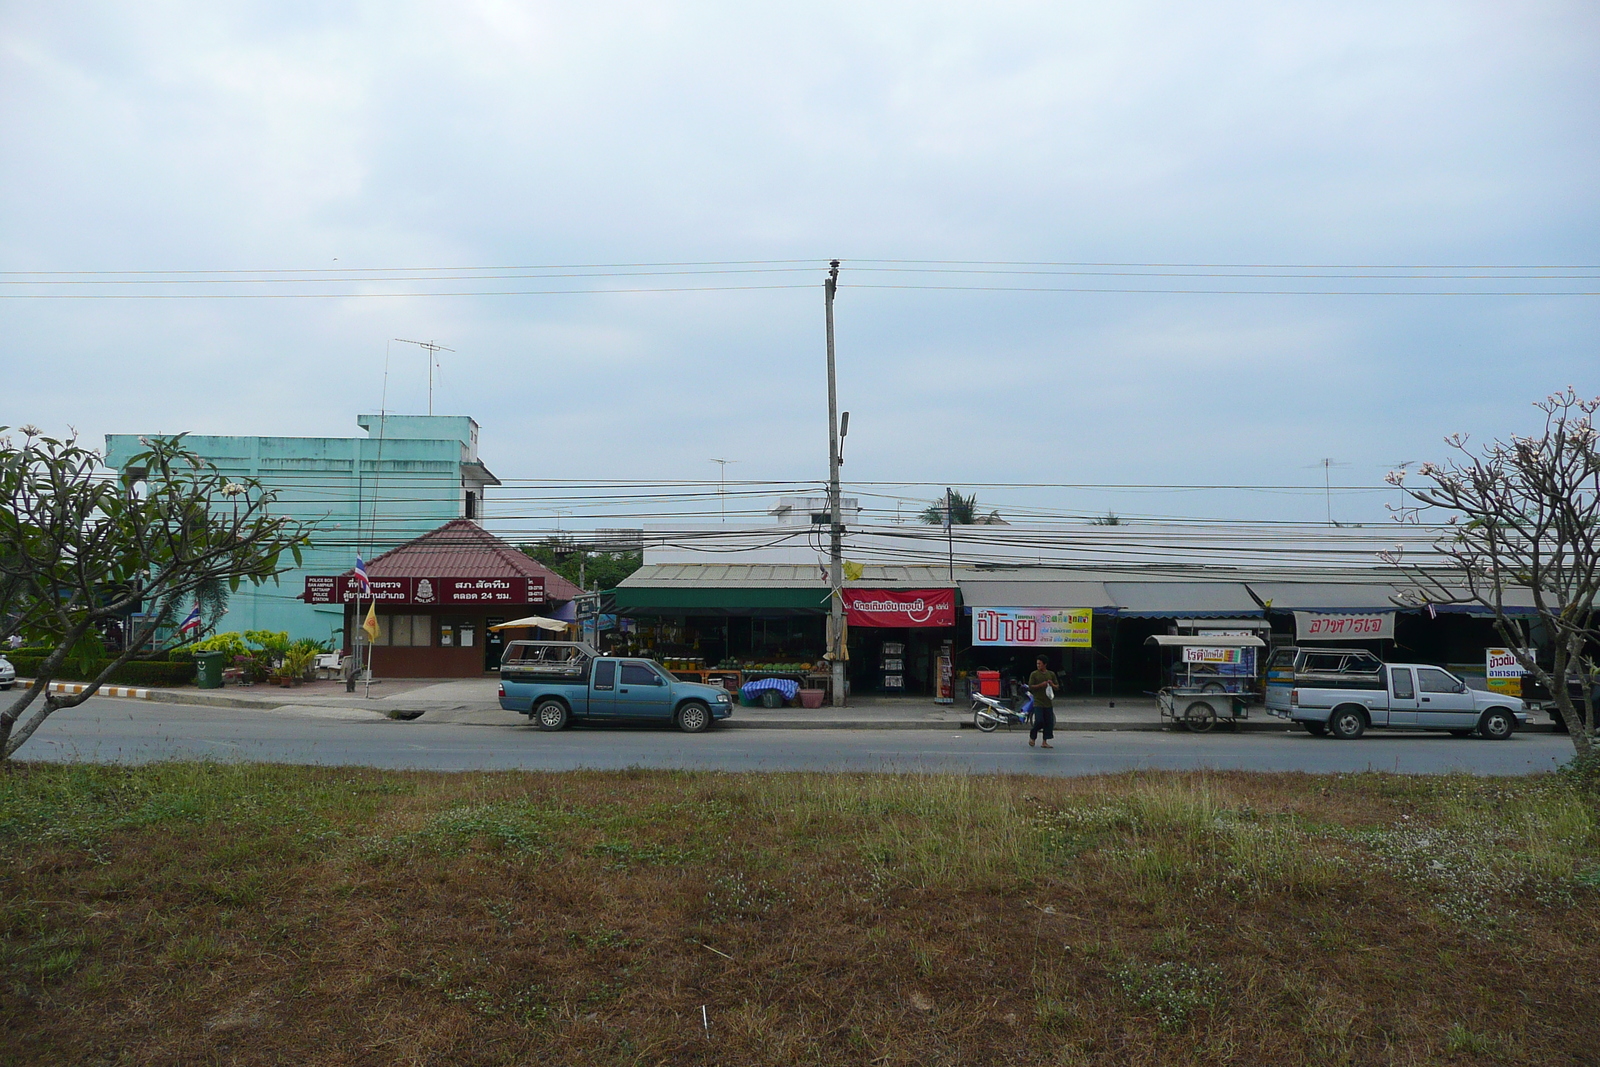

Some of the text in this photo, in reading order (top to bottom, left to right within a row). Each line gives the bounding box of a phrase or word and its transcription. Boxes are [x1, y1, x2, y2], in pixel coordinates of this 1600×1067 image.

[343, 590, 405, 602] ตู้ยามบานอำเภอ
[414, 596, 436, 604] POLICE
[480, 592, 493, 600] 24
[496, 592, 512, 600] ชม.
[1309, 618, 1382, 633] อาหารเจ
[1490, 654, 1515, 668] ข้าวต้ม
